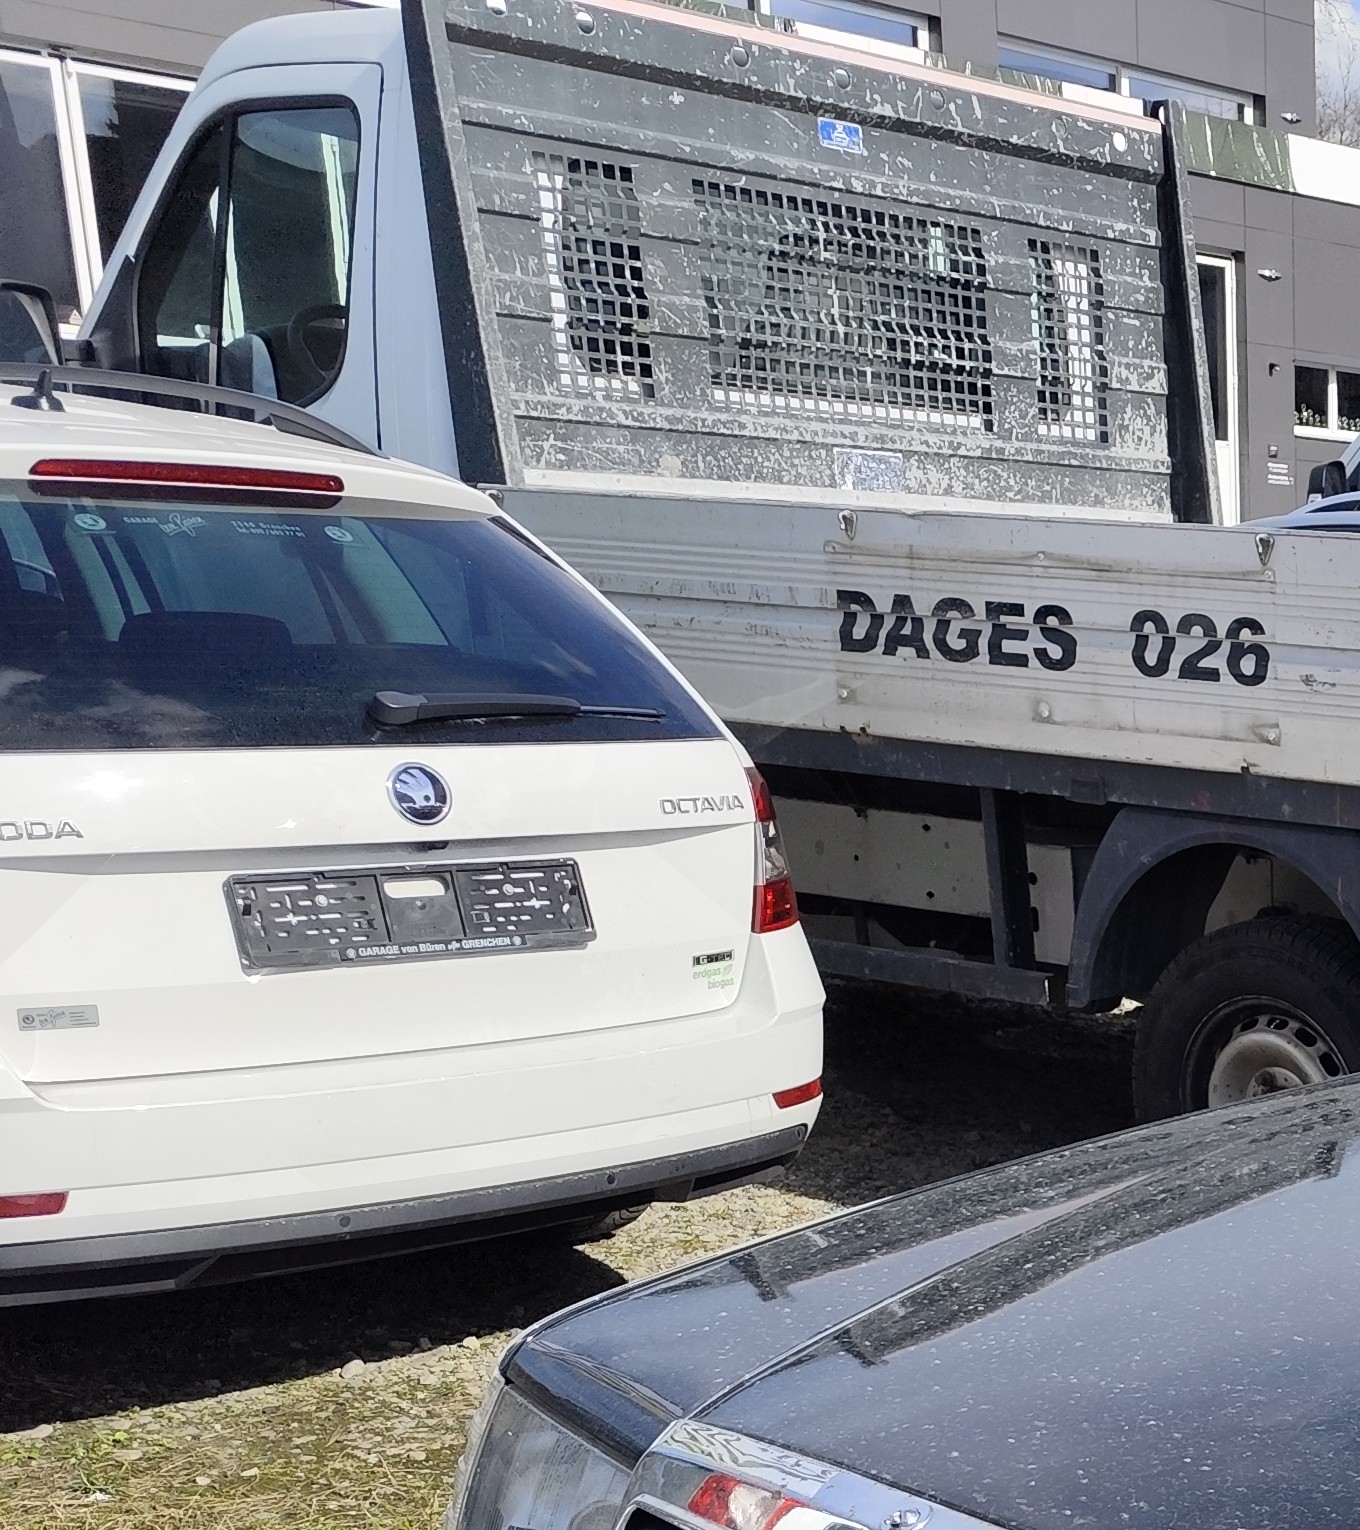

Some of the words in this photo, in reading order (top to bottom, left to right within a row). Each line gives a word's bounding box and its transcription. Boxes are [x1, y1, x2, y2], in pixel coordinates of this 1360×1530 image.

[836, 589, 1077, 672] DAGES
[1130, 609, 1270, 686] 026
[658, 794, 745, 815] OCTAVIA
[358, 944, 400, 957] GARAGE
[400, 945, 419, 955] von
[419, 942, 447, 953] Büren
[462, 936, 512, 949] GRENCHEN
[692, 968, 722, 979] erdgas
[707, 977, 735, 990] biogas
